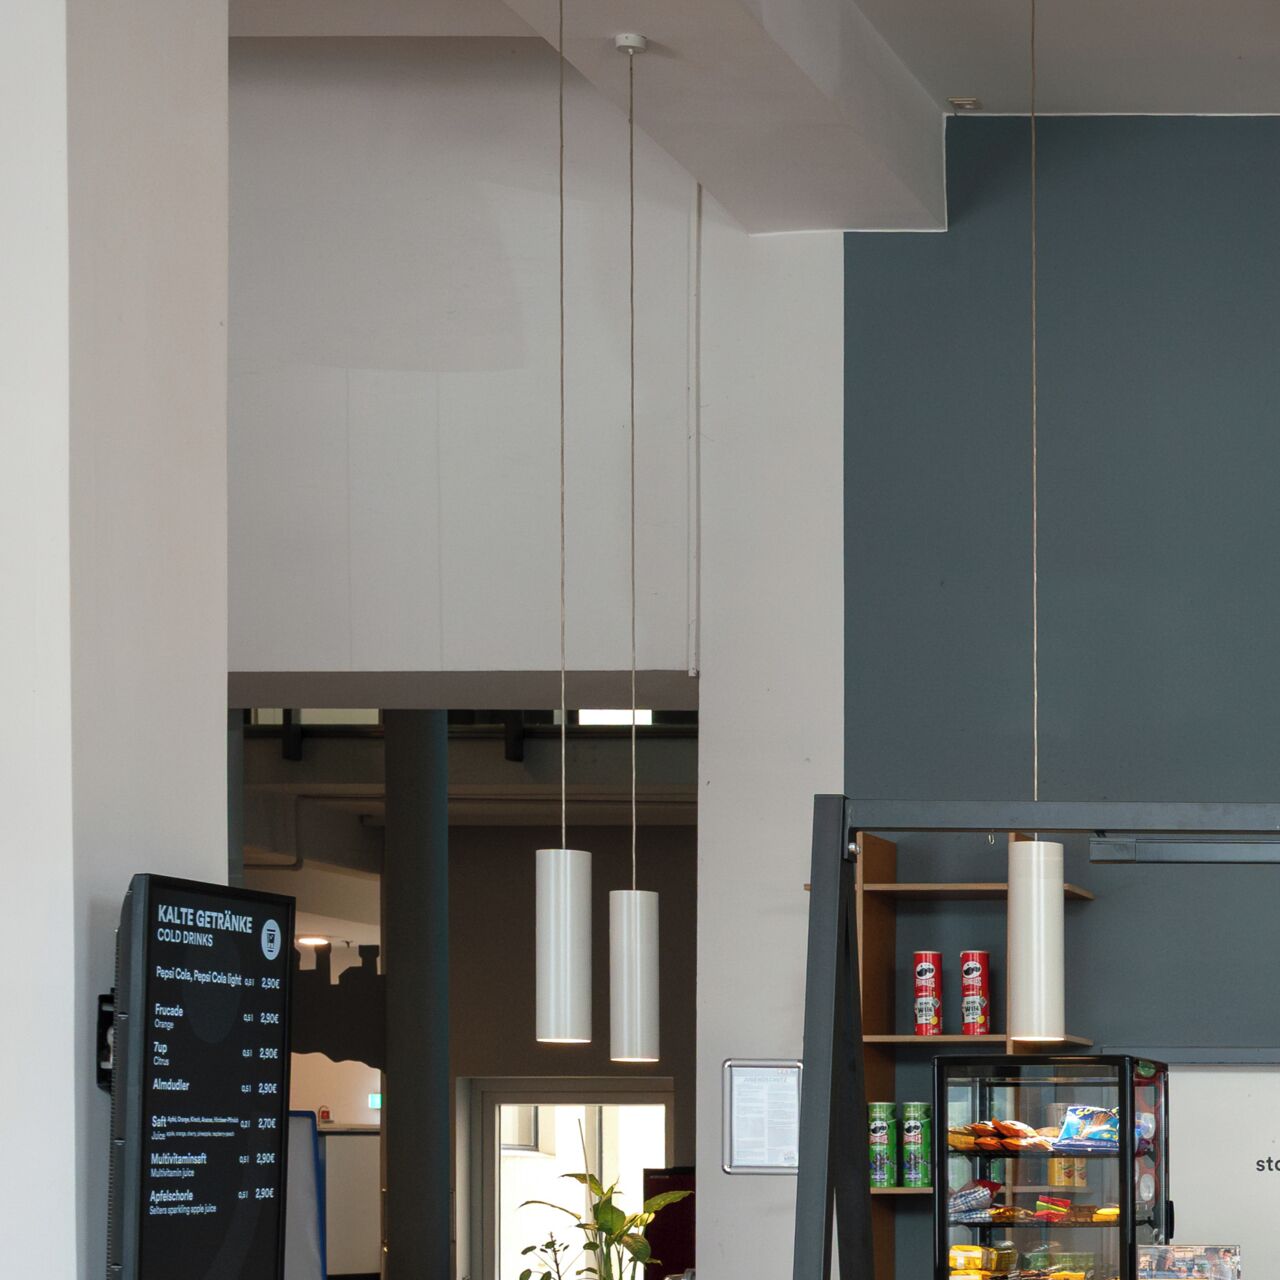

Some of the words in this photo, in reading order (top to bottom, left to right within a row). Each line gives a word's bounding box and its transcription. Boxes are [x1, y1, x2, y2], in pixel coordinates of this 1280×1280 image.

[158, 904, 194, 926] KALTE
[196, 910, 253, 934] GETRÄNKE
[157, 928, 182, 943] COLD
[183, 932, 214, 947] DRINKS
[156, 966, 174, 980] Pepsi
[175, 968, 193, 982] Cola,
[194, 970, 211, 984] Pepsi
[212, 972, 227, 984] Cola
[227, 973, 242, 988] light
[261, 978, 280, 990] 2,90€
[155, 1003, 184, 1017] Frucade
[260, 1012, 279, 1025] 2,90€
[154, 1019, 174, 1031] Orange
[153, 1042, 168, 1054] 7up
[260, 1048, 278, 1060] 2,90€
[153, 1056, 170, 1066] Citrus
[152, 1078, 190, 1091] Almdudler
[258, 1083, 277, 1096] 2,90€
[152, 1116, 166, 1128] Saft
[258, 1118, 276, 1130] 2,70€
[151, 1152, 207, 1164] Multivitaminsaft
[256, 1152, 275, 1164] 2,90€
[150, 1189, 193, 1204] Apfelschorle
[255, 1188, 274, 1200] 2,90€
[190, 1204, 204, 1215] apple
